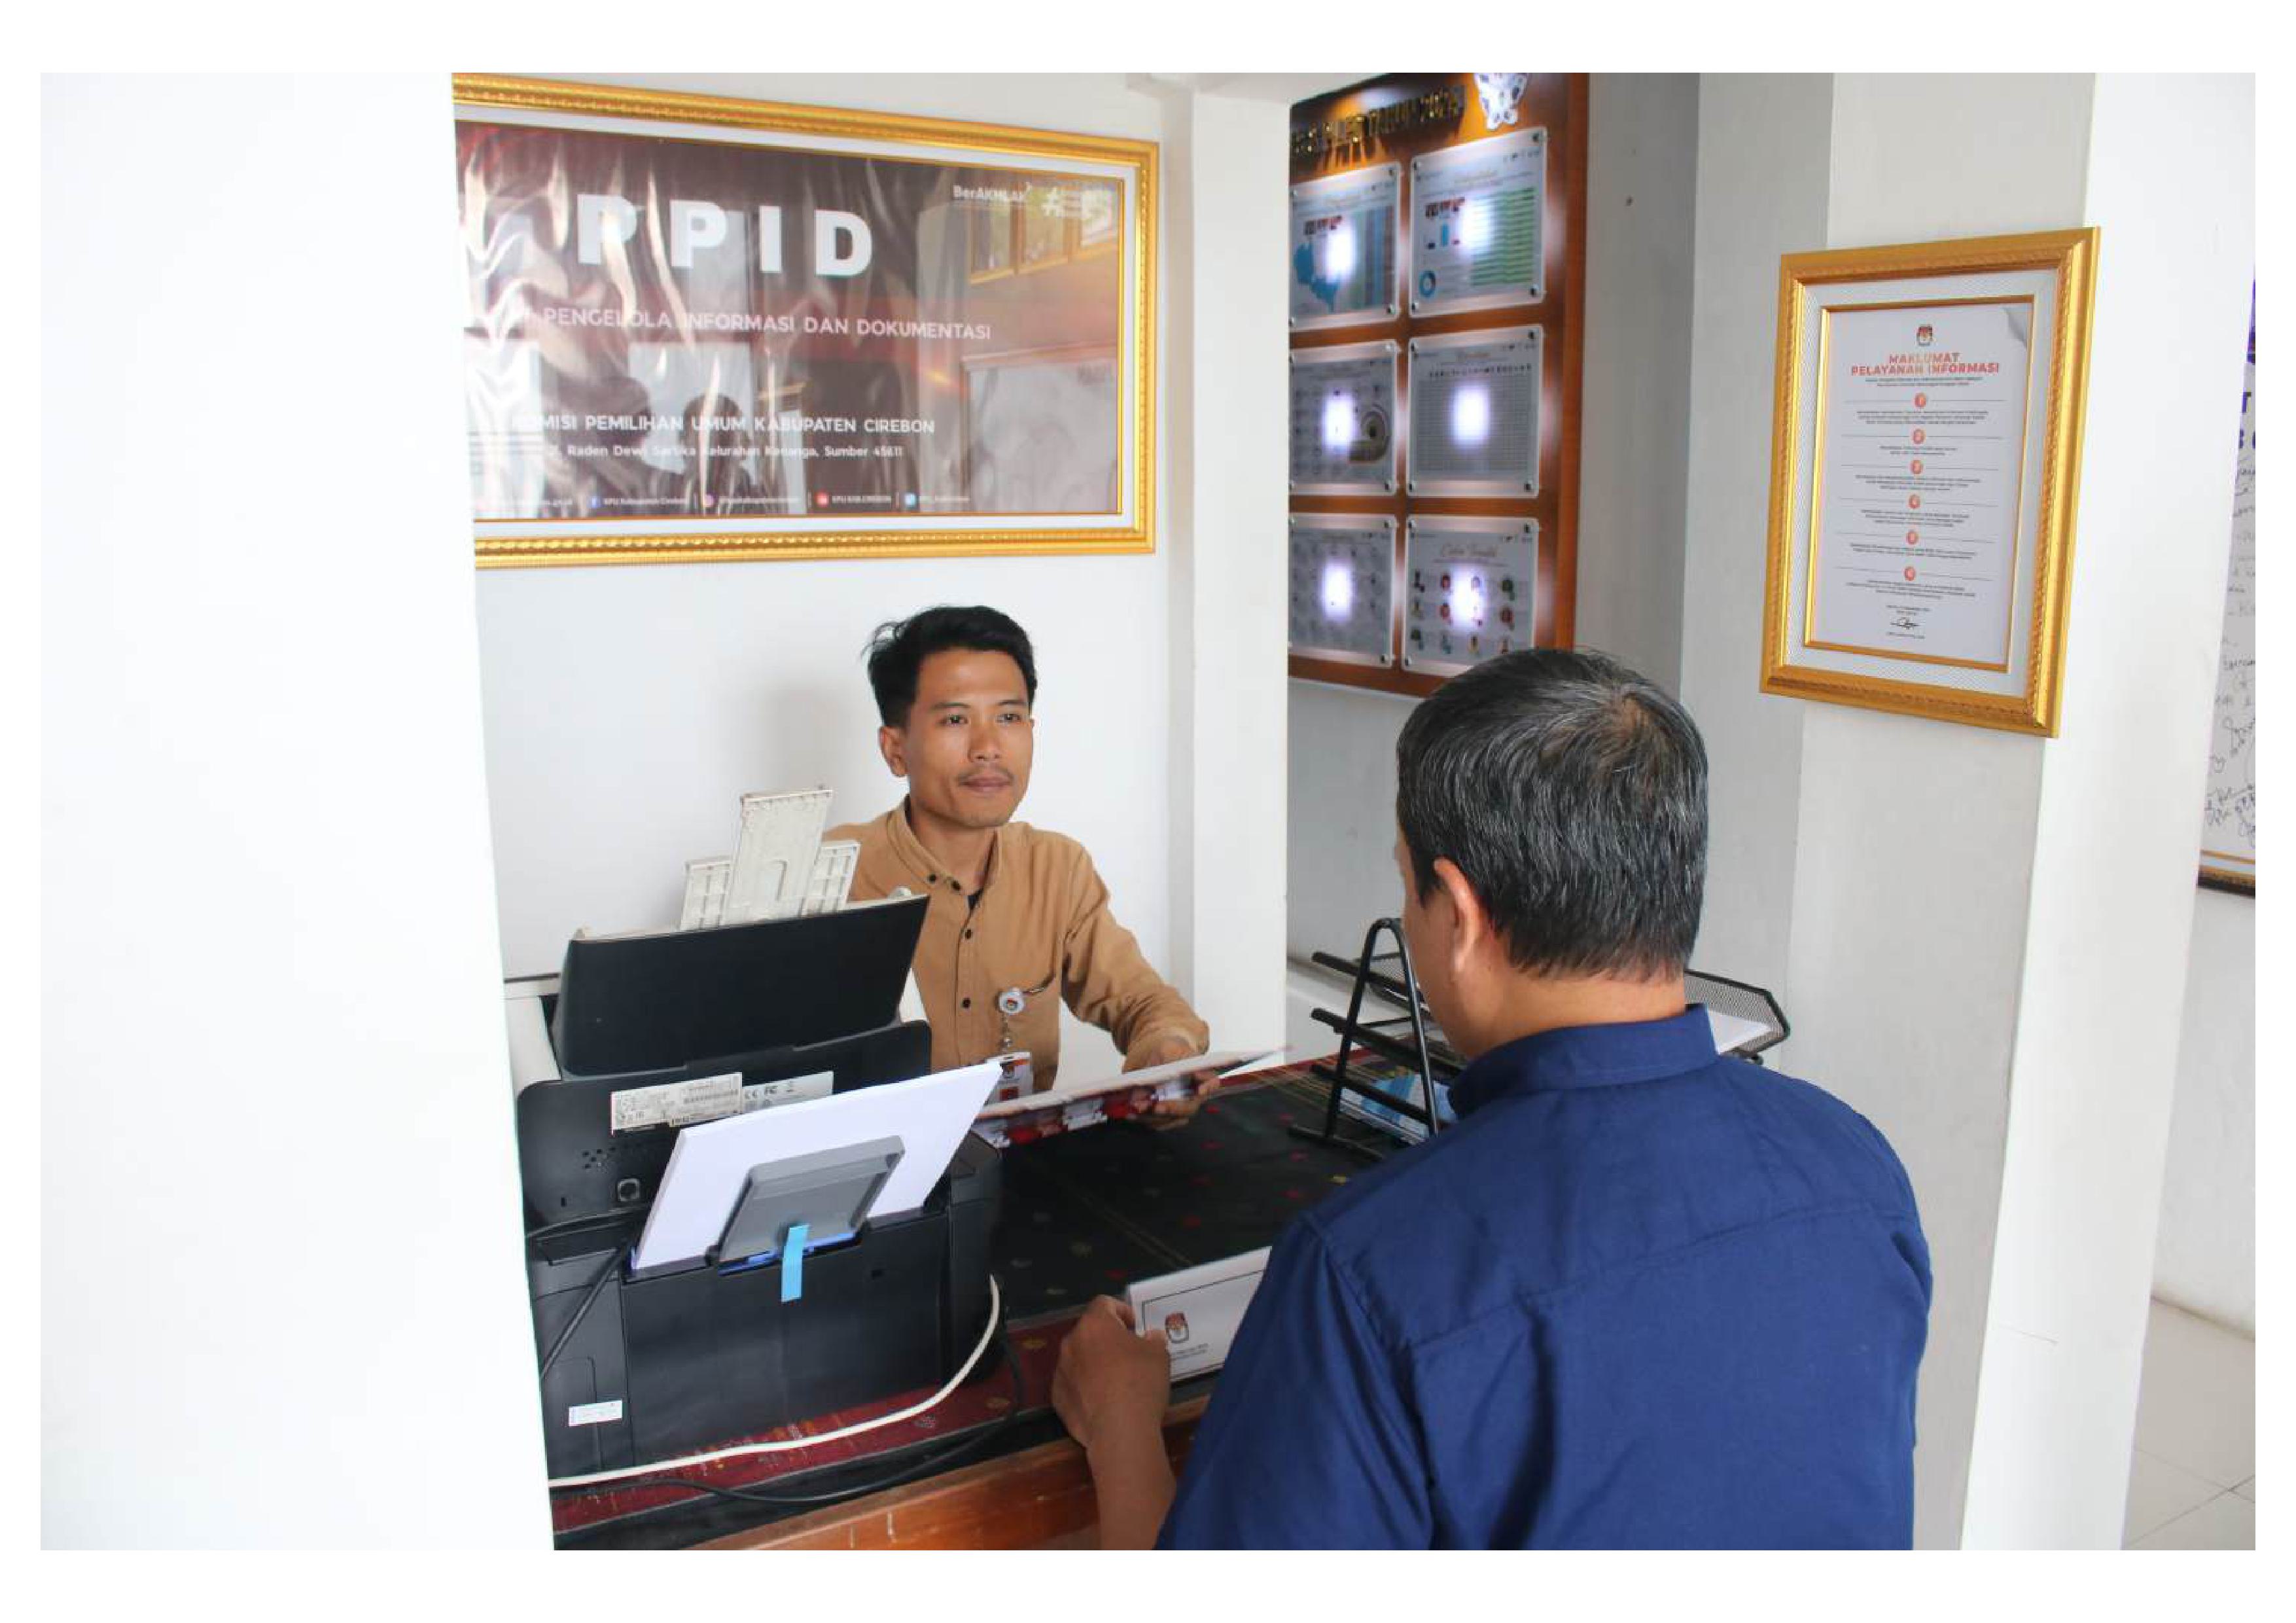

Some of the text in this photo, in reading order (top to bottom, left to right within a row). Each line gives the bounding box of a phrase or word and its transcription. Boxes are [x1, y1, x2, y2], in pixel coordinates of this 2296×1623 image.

[577, 194, 872, 276] PPID
[804, 317, 849, 334] DAN
[857, 319, 991, 340] DOKUMENTASI
[1889, 352, 1960, 364] MAKLUMAT
[1851, 363, 2000, 376] PELAYANAN INFORMASI
[585, 415, 684, 431] PEMILIHAN
[754, 416, 857, 433] KABUPATEN
[864, 418, 935, 434] CIREBON
[824, 446, 868, 457] Sumber
